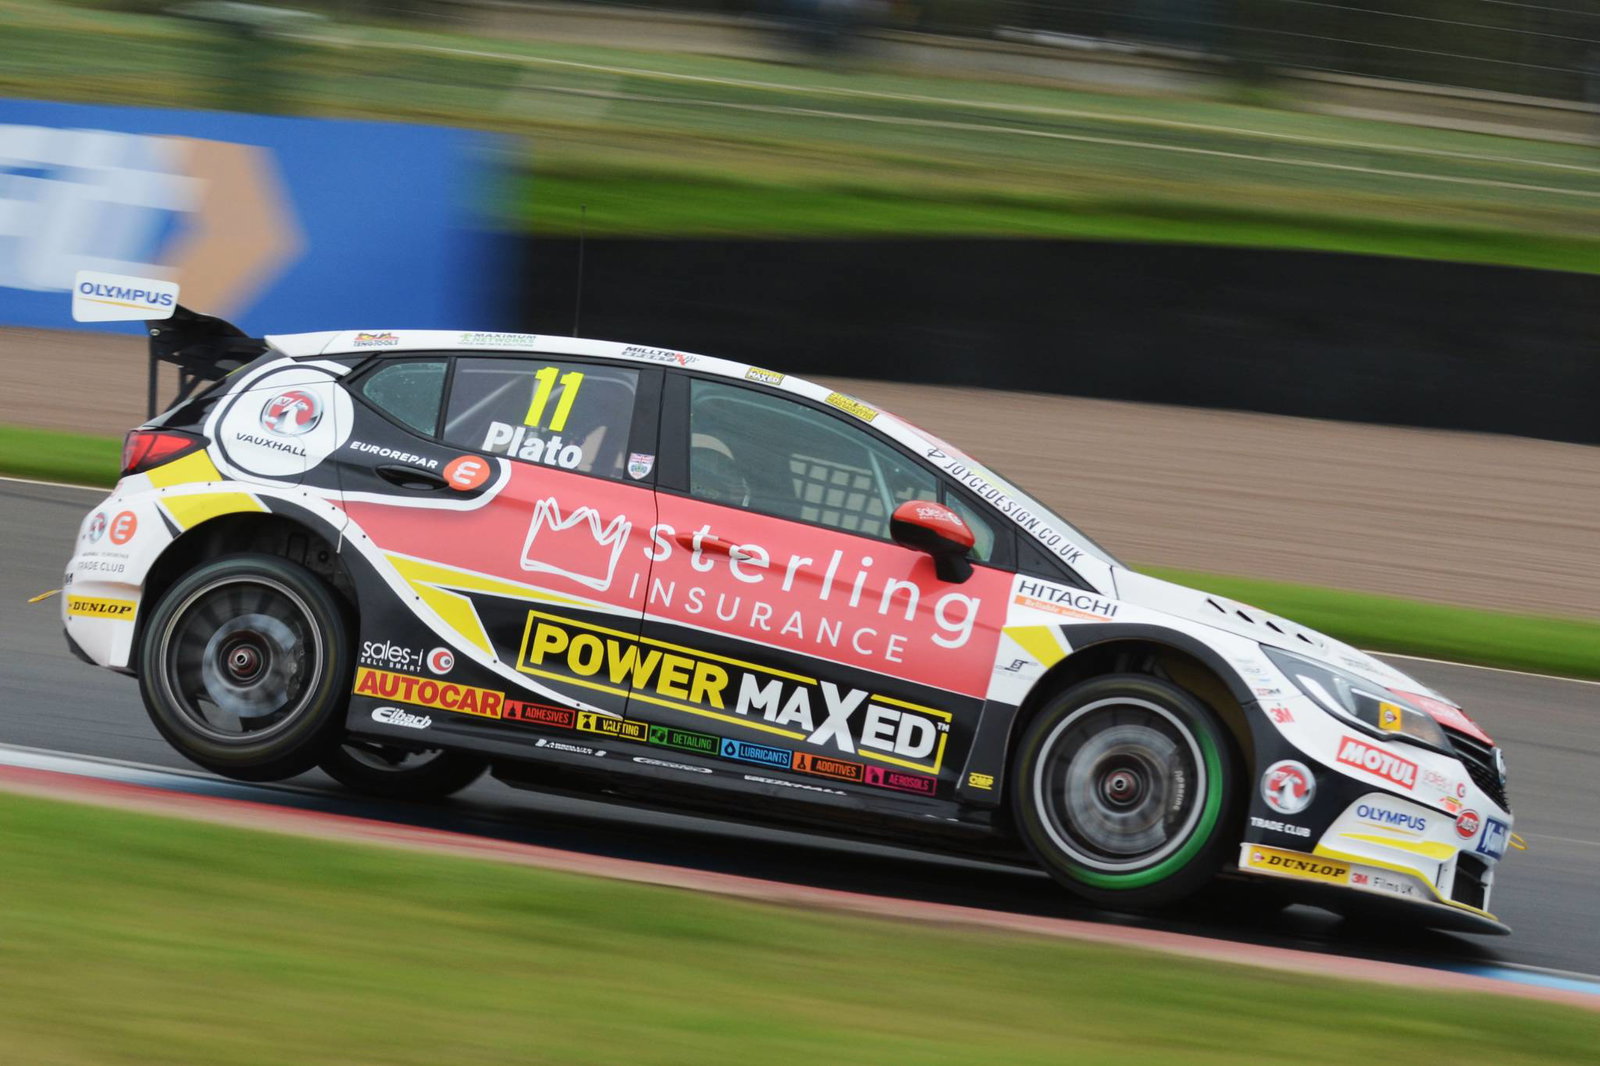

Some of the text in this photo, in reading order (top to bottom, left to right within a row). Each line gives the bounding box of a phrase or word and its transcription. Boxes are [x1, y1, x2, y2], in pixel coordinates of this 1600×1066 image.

[79, 281, 173, 307] OLYMPUS
[524, 366, 585, 432] 11
[235, 432, 307, 458] VAUXHALL
[350, 441, 439, 470] EUROREPAR
[482, 421, 583, 469] Plato
[945, 461, 1085, 564] JOYCEDESIGN.CO.UK
[100, 562, 125, 573] CLUB
[643, 523, 981, 649] sterling
[73, 602, 132, 614] DUNLOP
[1018, 580, 1119, 617] HITACHI
[629, 572, 909, 664] INSURANCE
[360, 656, 422, 673] SELL SMART
[357, 671, 501, 717] AUTOCAR
[528, 622, 730, 710] POWER
[734, 671, 938, 760] MAXED
[371, 706, 432, 729] Eibach
[525, 706, 570, 724] ADHESIVES
[1270, 707, 1294, 723] 3M
[672, 732, 712, 750] DETAILING
[740, 745, 789, 765] LUBRICANTS
[1340, 740, 1417, 786] MOTUL
[815, 758, 857, 778] ADDITIVES
[887, 771, 931, 791] AEROSOLS
[1250, 816, 1311, 838] TRADE CLUB
[1357, 804, 1426, 831] OLYMPUS
[1266, 856, 1346, 877] DUNLOP
[1351, 872, 1369, 885] 3M
[1373, 876, 1400, 893] Films
